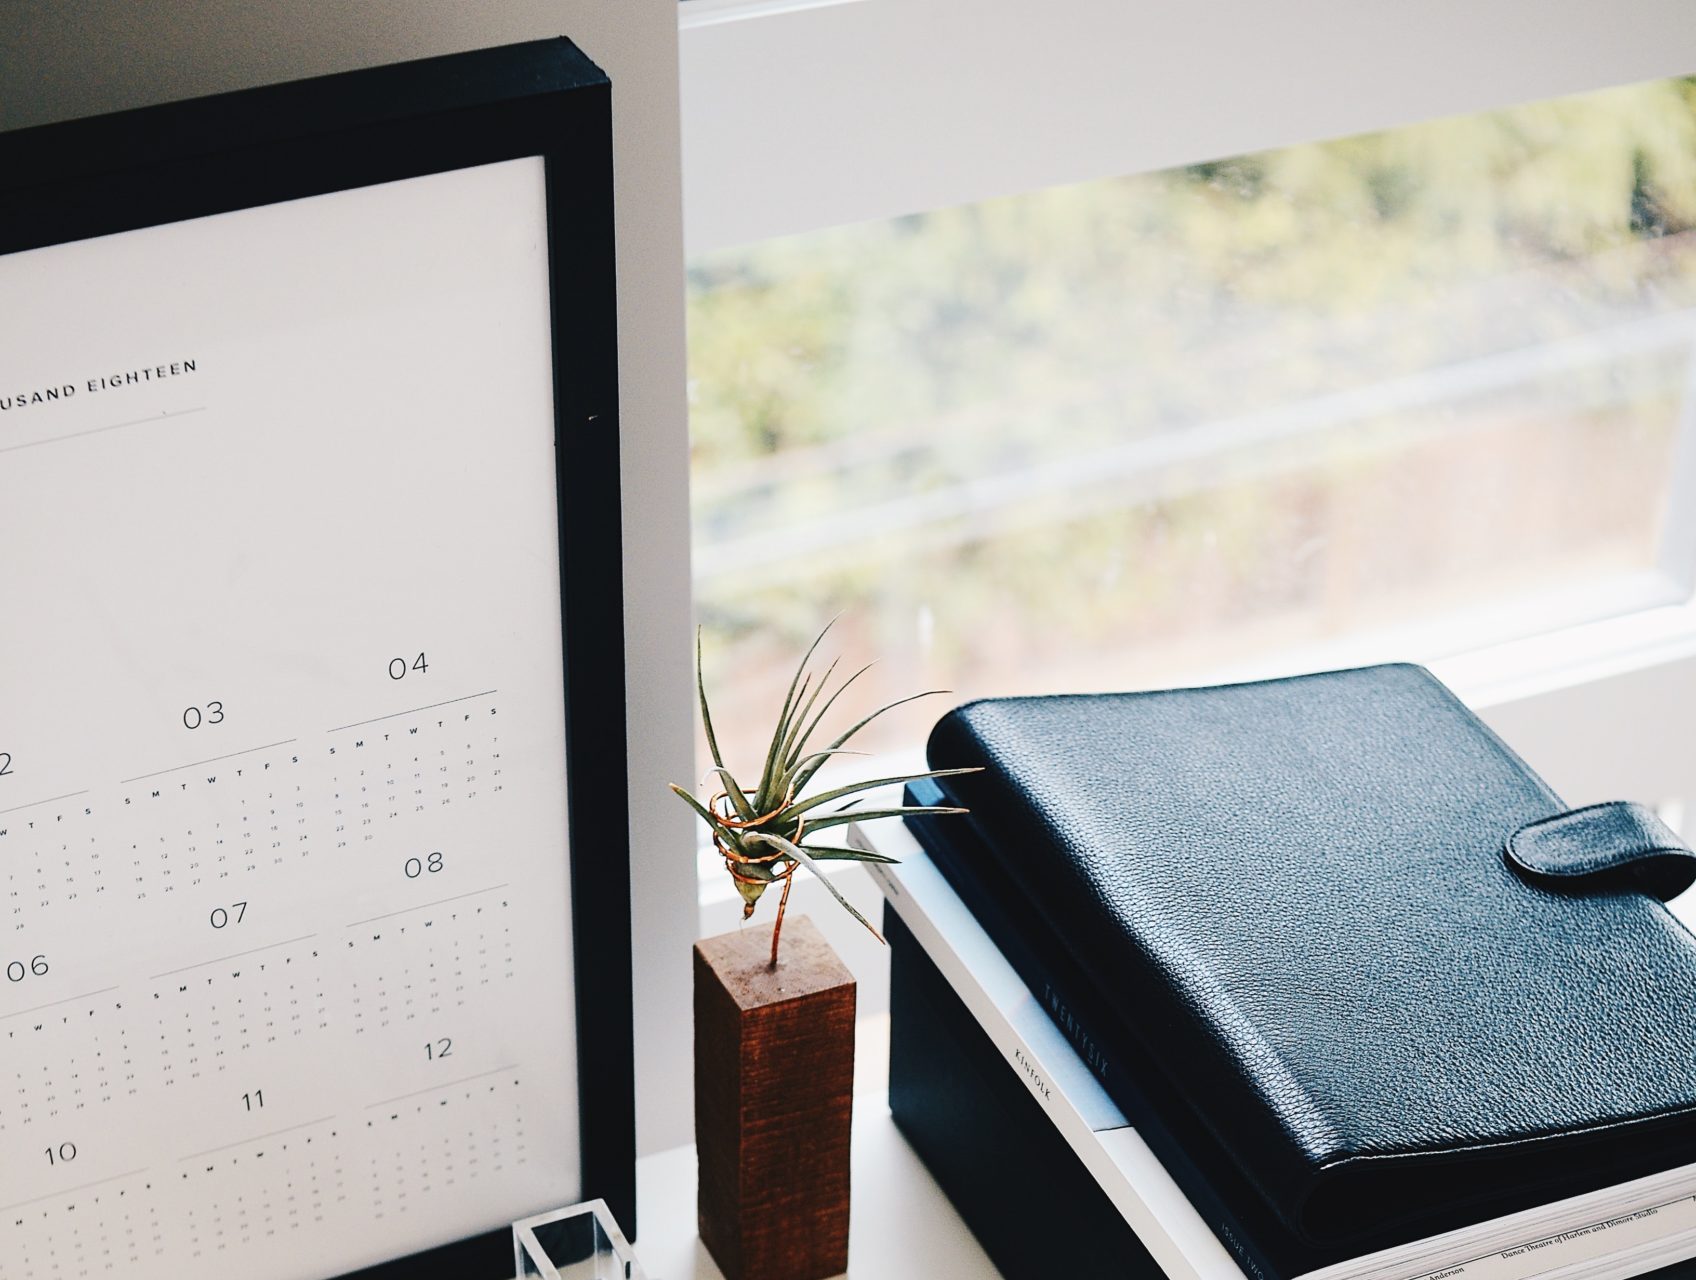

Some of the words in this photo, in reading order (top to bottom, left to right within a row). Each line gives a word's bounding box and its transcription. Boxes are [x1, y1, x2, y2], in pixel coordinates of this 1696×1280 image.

[0, 386, 76, 411] USAND
[87, 359, 197, 393] EIGHTEEN
[388, 651, 429, 681] 04
[183, 701, 225, 730] 03
[328, 746, 337, 756] S
[354, 739, 365, 749] M
[383, 732, 391, 743] T
[408, 726, 419, 736] W
[436, 719, 445, 730] T
[463, 712, 471, 723] F
[489, 706, 498, 717] S
[0, 752, 14, 777] 2
[123, 796, 132, 806] S
[150, 789, 162, 799] M
[180, 781, 188, 792] T
[206, 775, 217, 785] W
[235, 768, 243, 778] T
[263, 761, 271, 772] F
[291, 754, 299, 765] S
[0, 828, 9, 838] W
[27, 820, 35, 831] T
[54, 813, 63, 824] F
[84, 806, 92, 817] S
[404, 851, 444, 879] 08
[210, 901, 248, 929] 07
[6, 954, 49, 983] 06
[424, 1037, 452, 1061] 12
[1015, 1048, 1051, 1101] KINFOLK
[241, 1089, 264, 1112] 11
[44, 1142, 77, 1166] 10
[1221, 1222, 1245, 1256] ISSUE
[1500, 1247, 1525, 1260] Dance
[1526, 1239, 1553, 1253] Theatre
[1554, 1234, 1563, 1244] of
[1562, 1228, 1591, 1241] Harlem
[1591, 1222, 1606, 1234] and
[1606, 1215, 1634, 1229] Dimore
[1634, 1208, 1658, 1221] Studio
